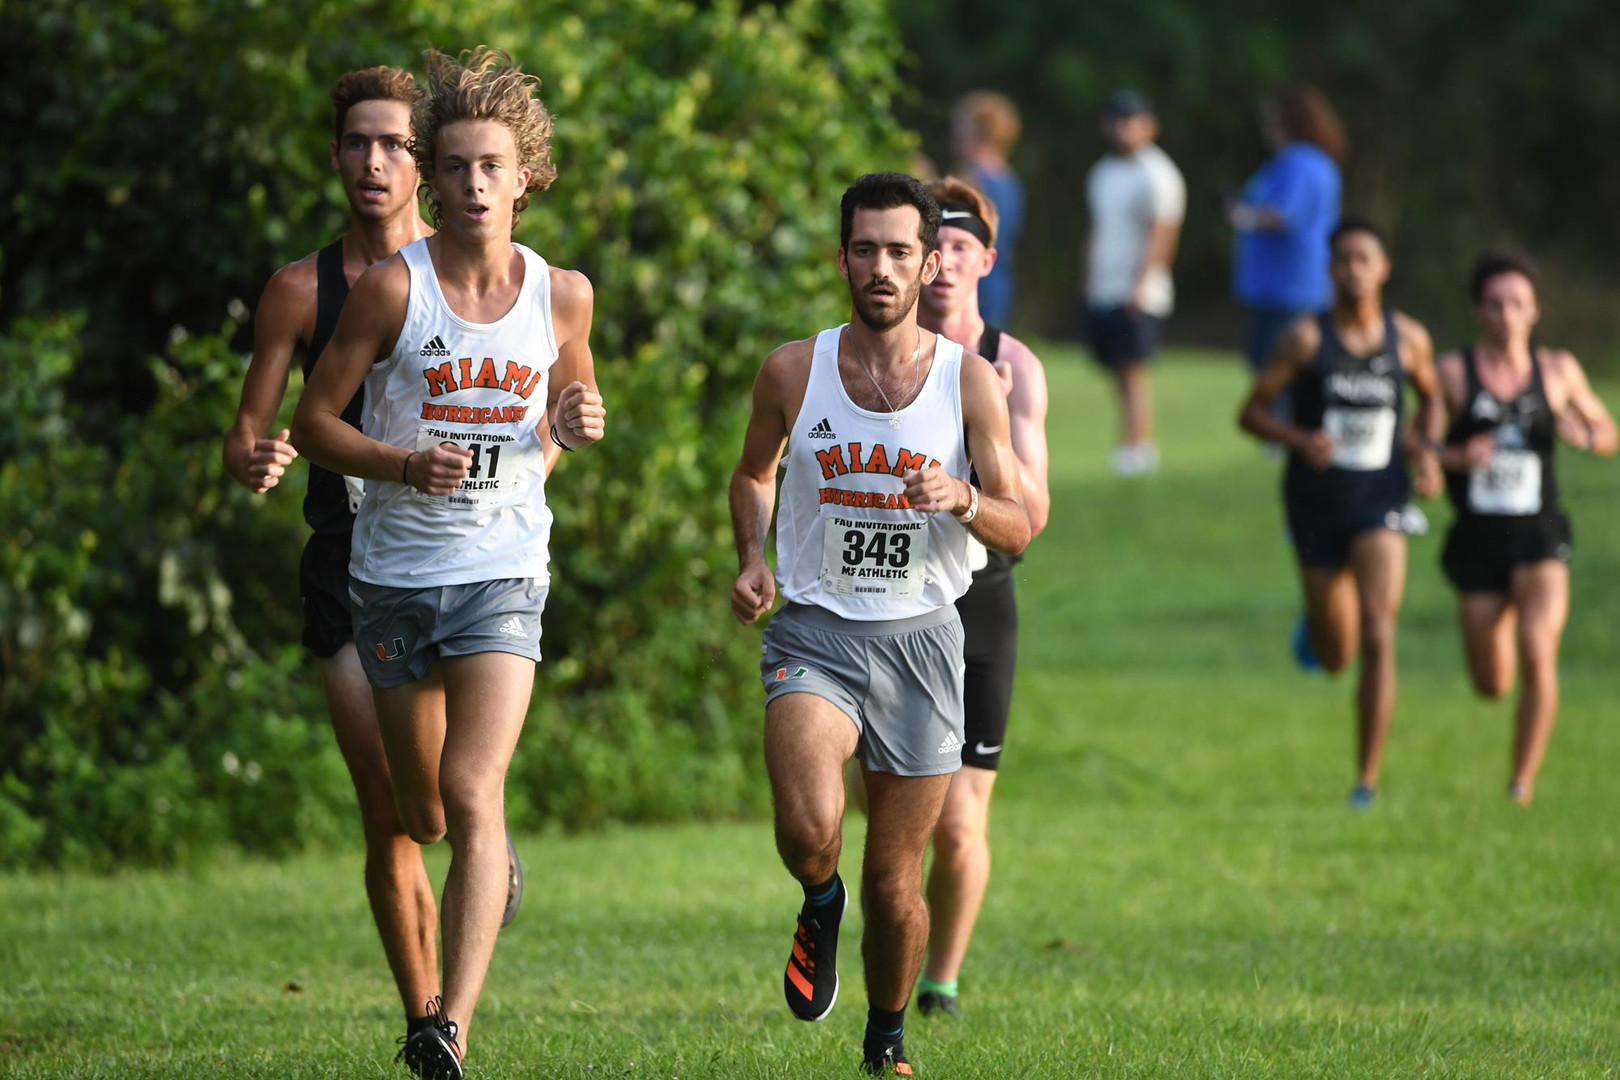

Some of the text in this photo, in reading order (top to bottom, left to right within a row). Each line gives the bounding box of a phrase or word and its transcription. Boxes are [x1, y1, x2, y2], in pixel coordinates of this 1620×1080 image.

[419, 349, 451, 357] adidas
[423, 357, 542, 400] MIAMI
[428, 428, 447, 439] FAU
[808, 430, 837, 440] adidas
[439, 440, 501, 479] 41
[815, 442, 942, 481] MIAM
[455, 480, 500, 490] THLETIC
[818, 487, 916, 510] HURRICAN
[834, 517, 922, 531] FAU INVITATIONAL
[842, 530, 911, 568] 343
[858, 568, 909, 579] ATHLETIC
